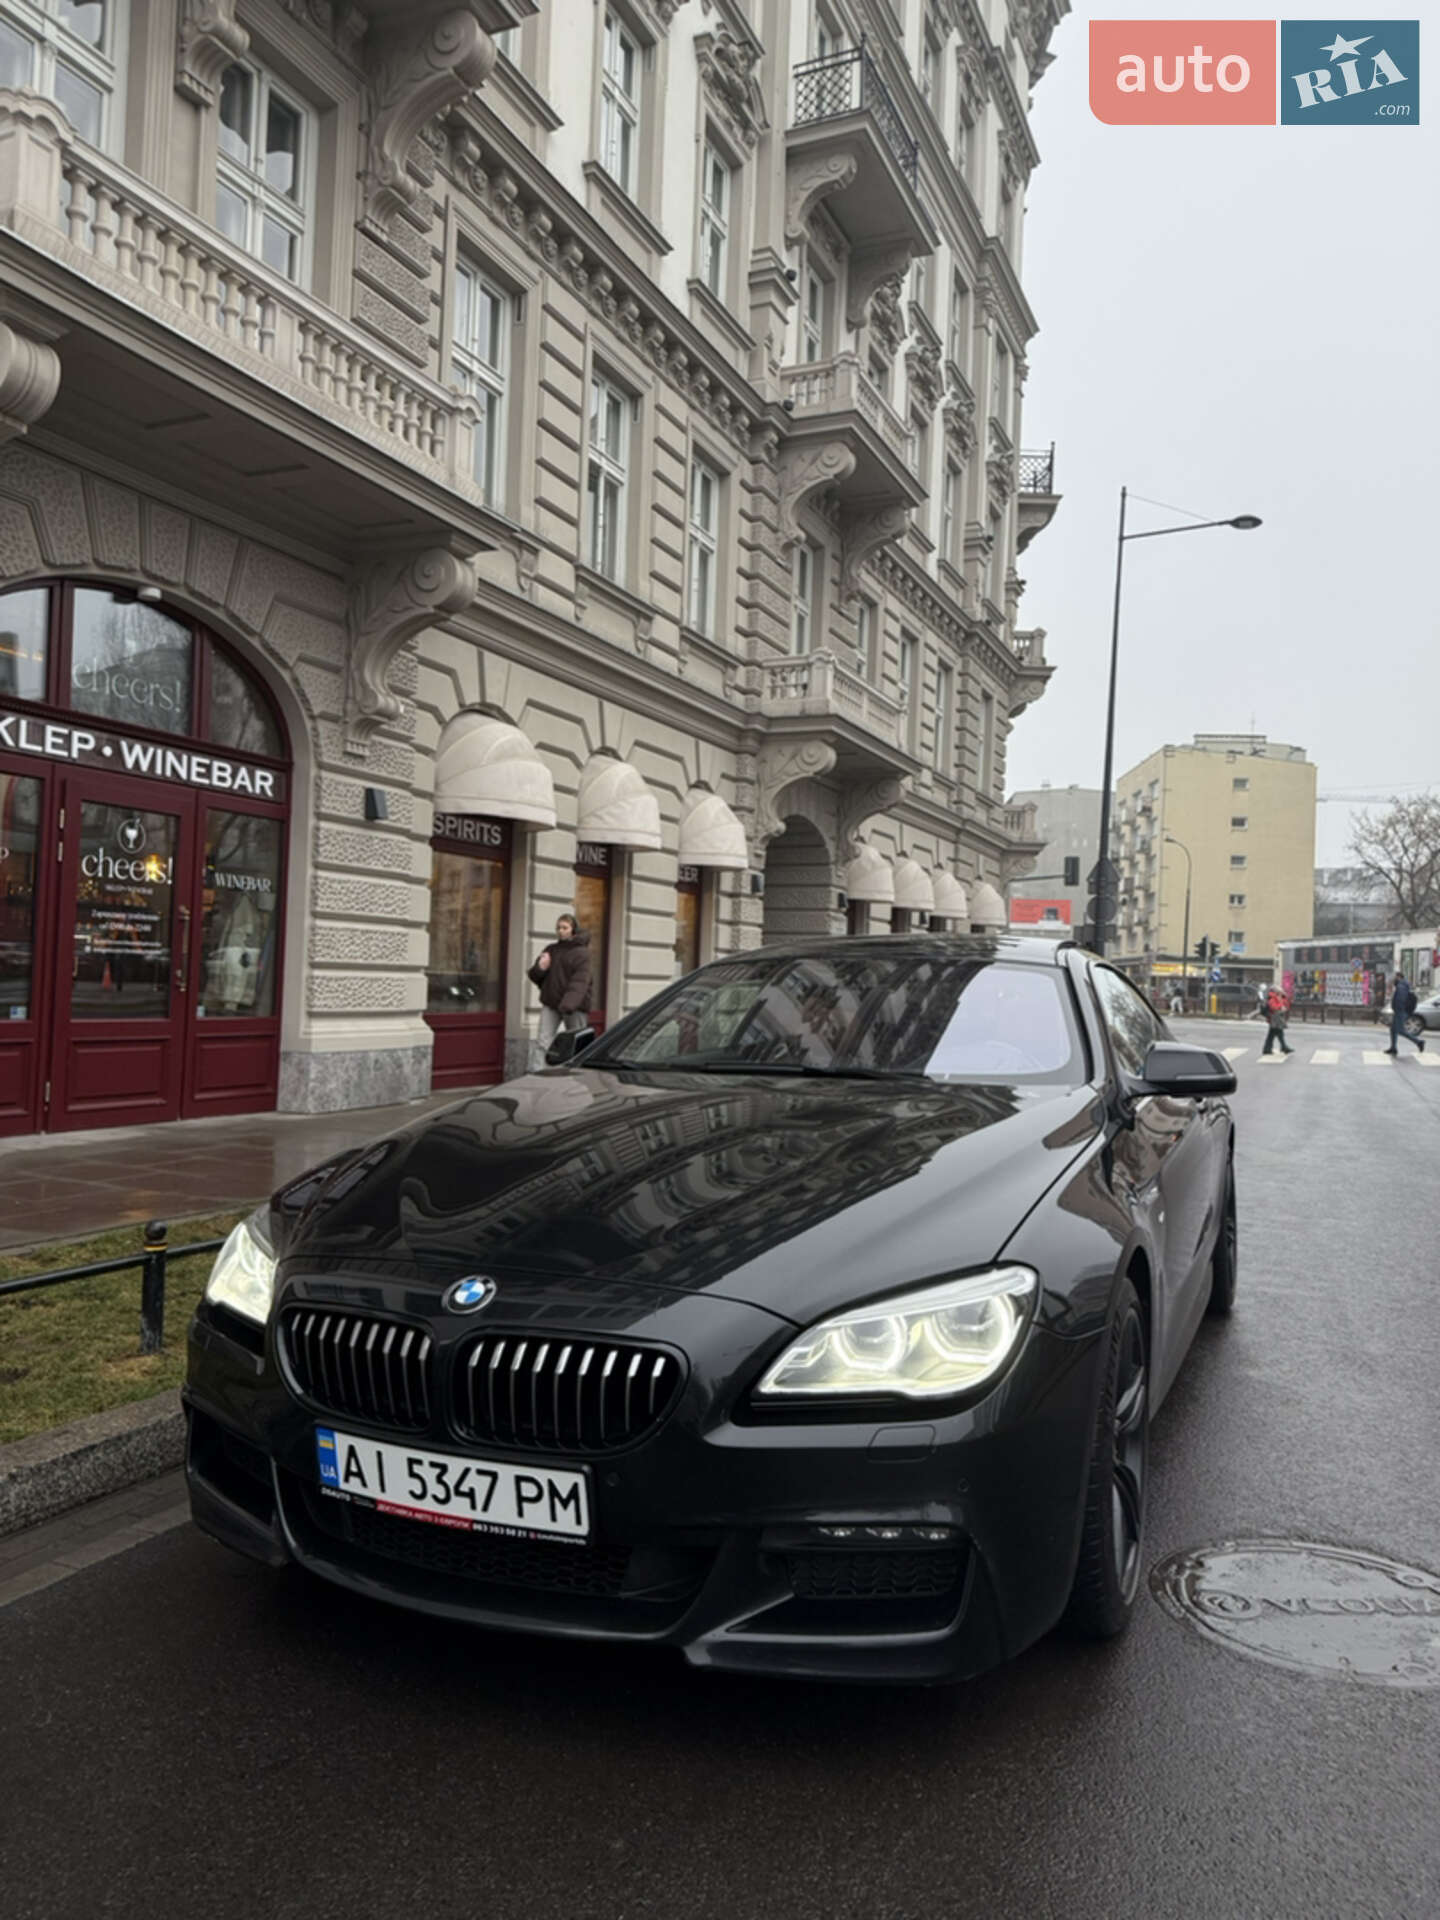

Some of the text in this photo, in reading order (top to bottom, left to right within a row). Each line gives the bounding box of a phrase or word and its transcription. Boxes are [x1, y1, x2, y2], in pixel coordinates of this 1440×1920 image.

[73, 657, 181, 713] cheers!
[120, 740, 275, 797] WINEBAR
[433, 815, 503, 845] SPIRITS
[81, 848, 174, 885] cheers!
[214, 871, 272, 893] WINEBAR
[320, 1463, 338, 1480] UA
[343, 1444, 582, 1526] AI 5347 PM
